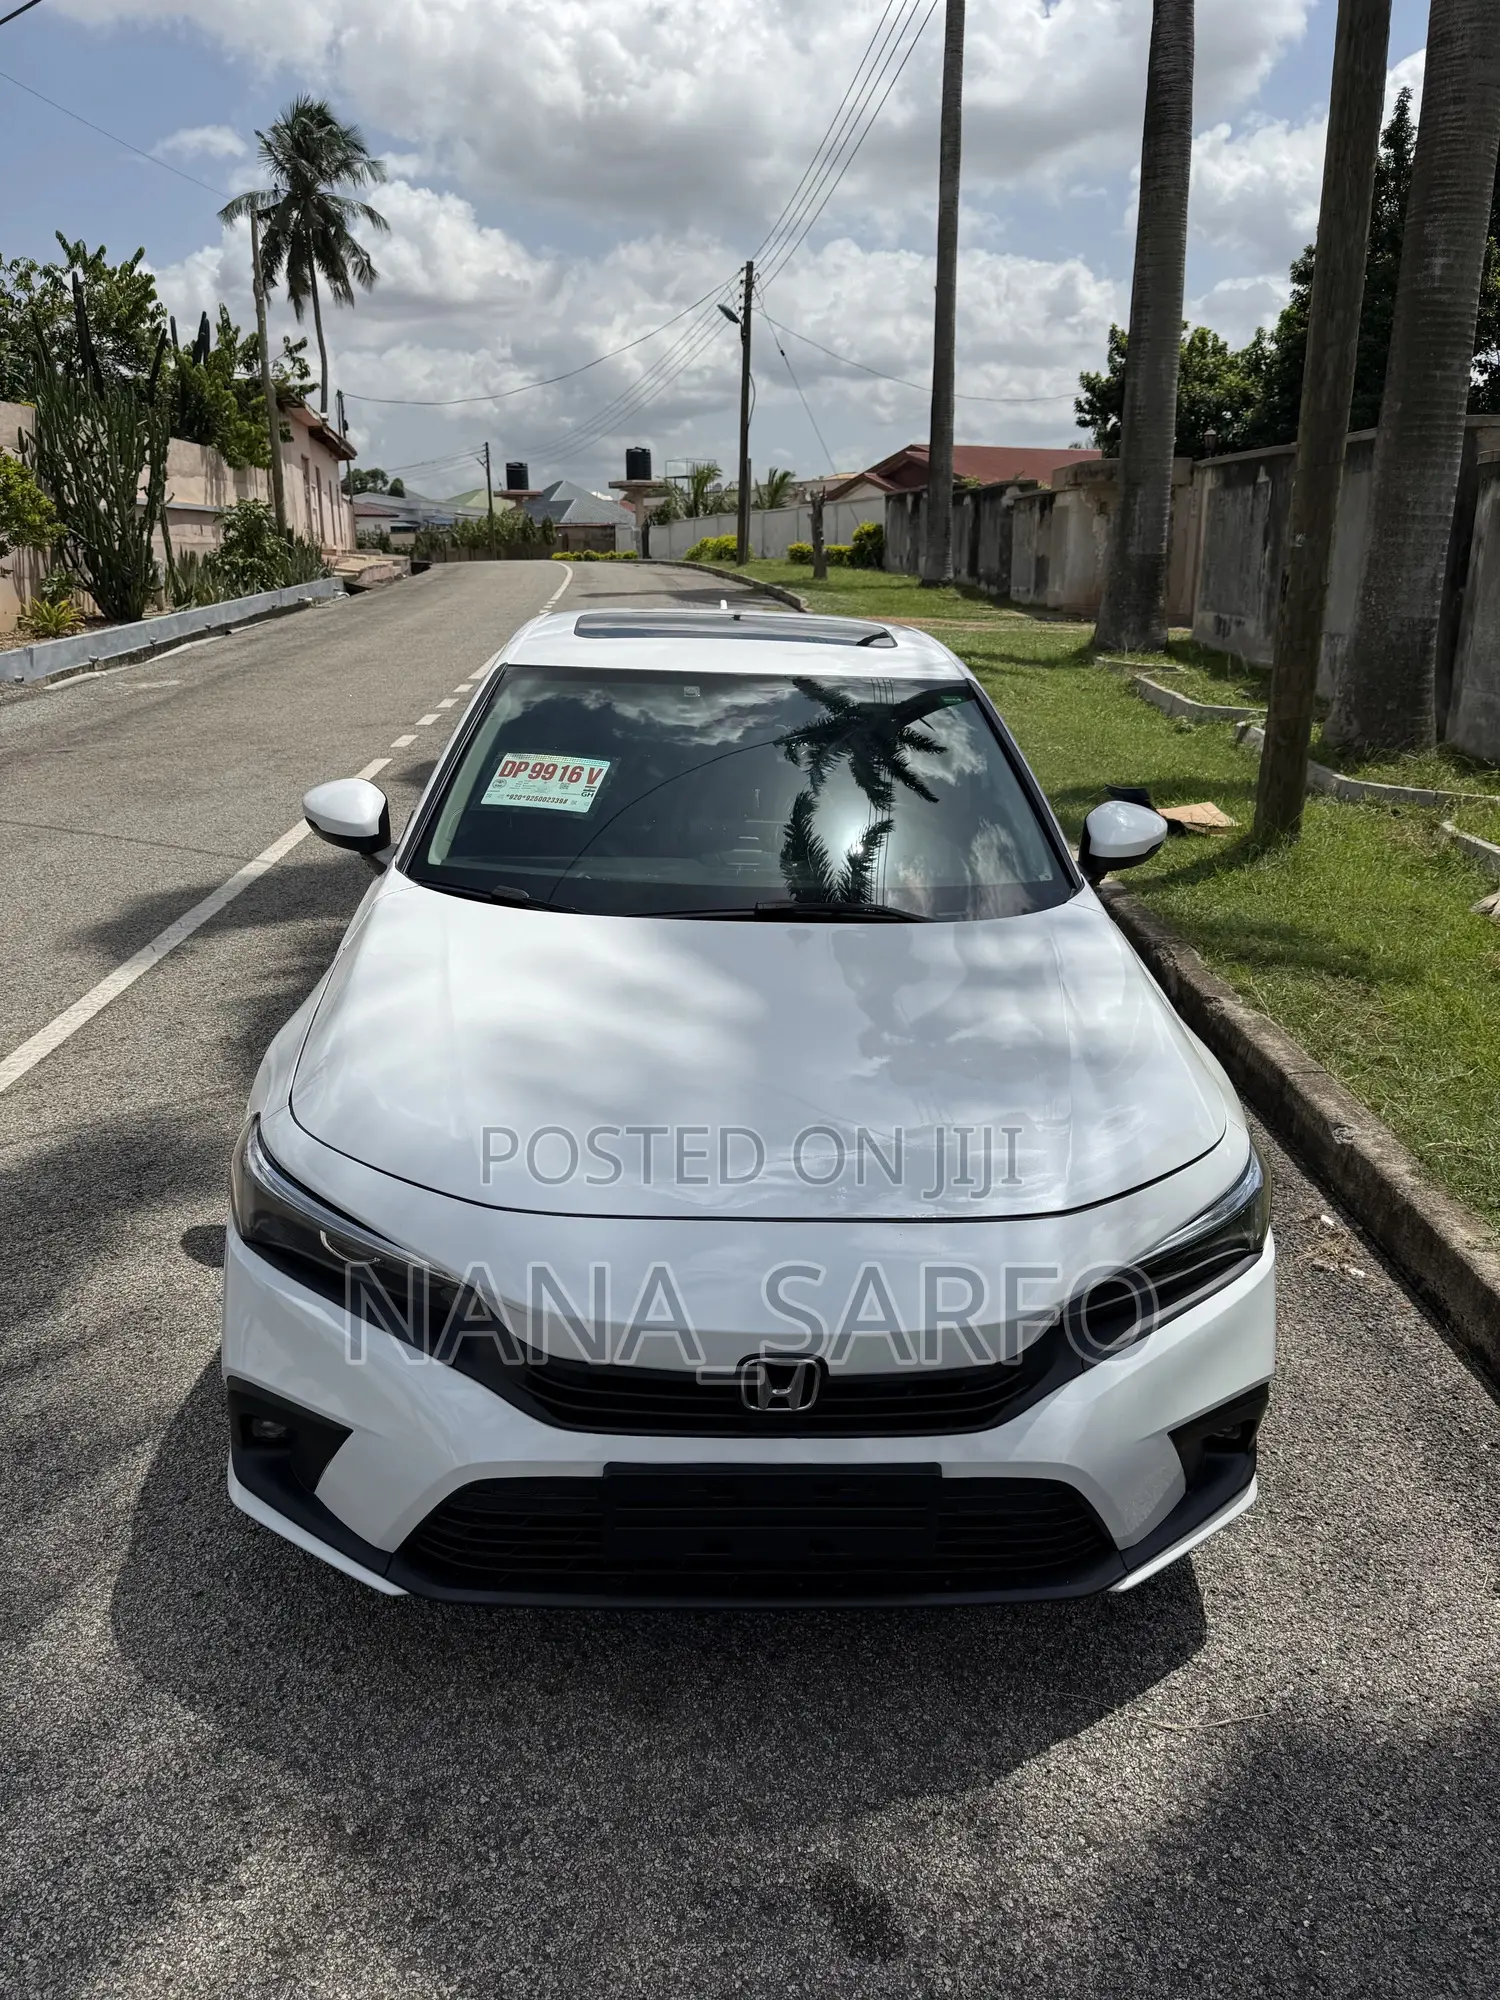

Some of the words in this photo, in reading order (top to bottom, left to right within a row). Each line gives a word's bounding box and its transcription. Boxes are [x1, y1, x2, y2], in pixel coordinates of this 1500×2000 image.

[498, 760, 530, 779] DP
[528, 762, 585, 784] 9916
[586, 767, 604, 785] V
